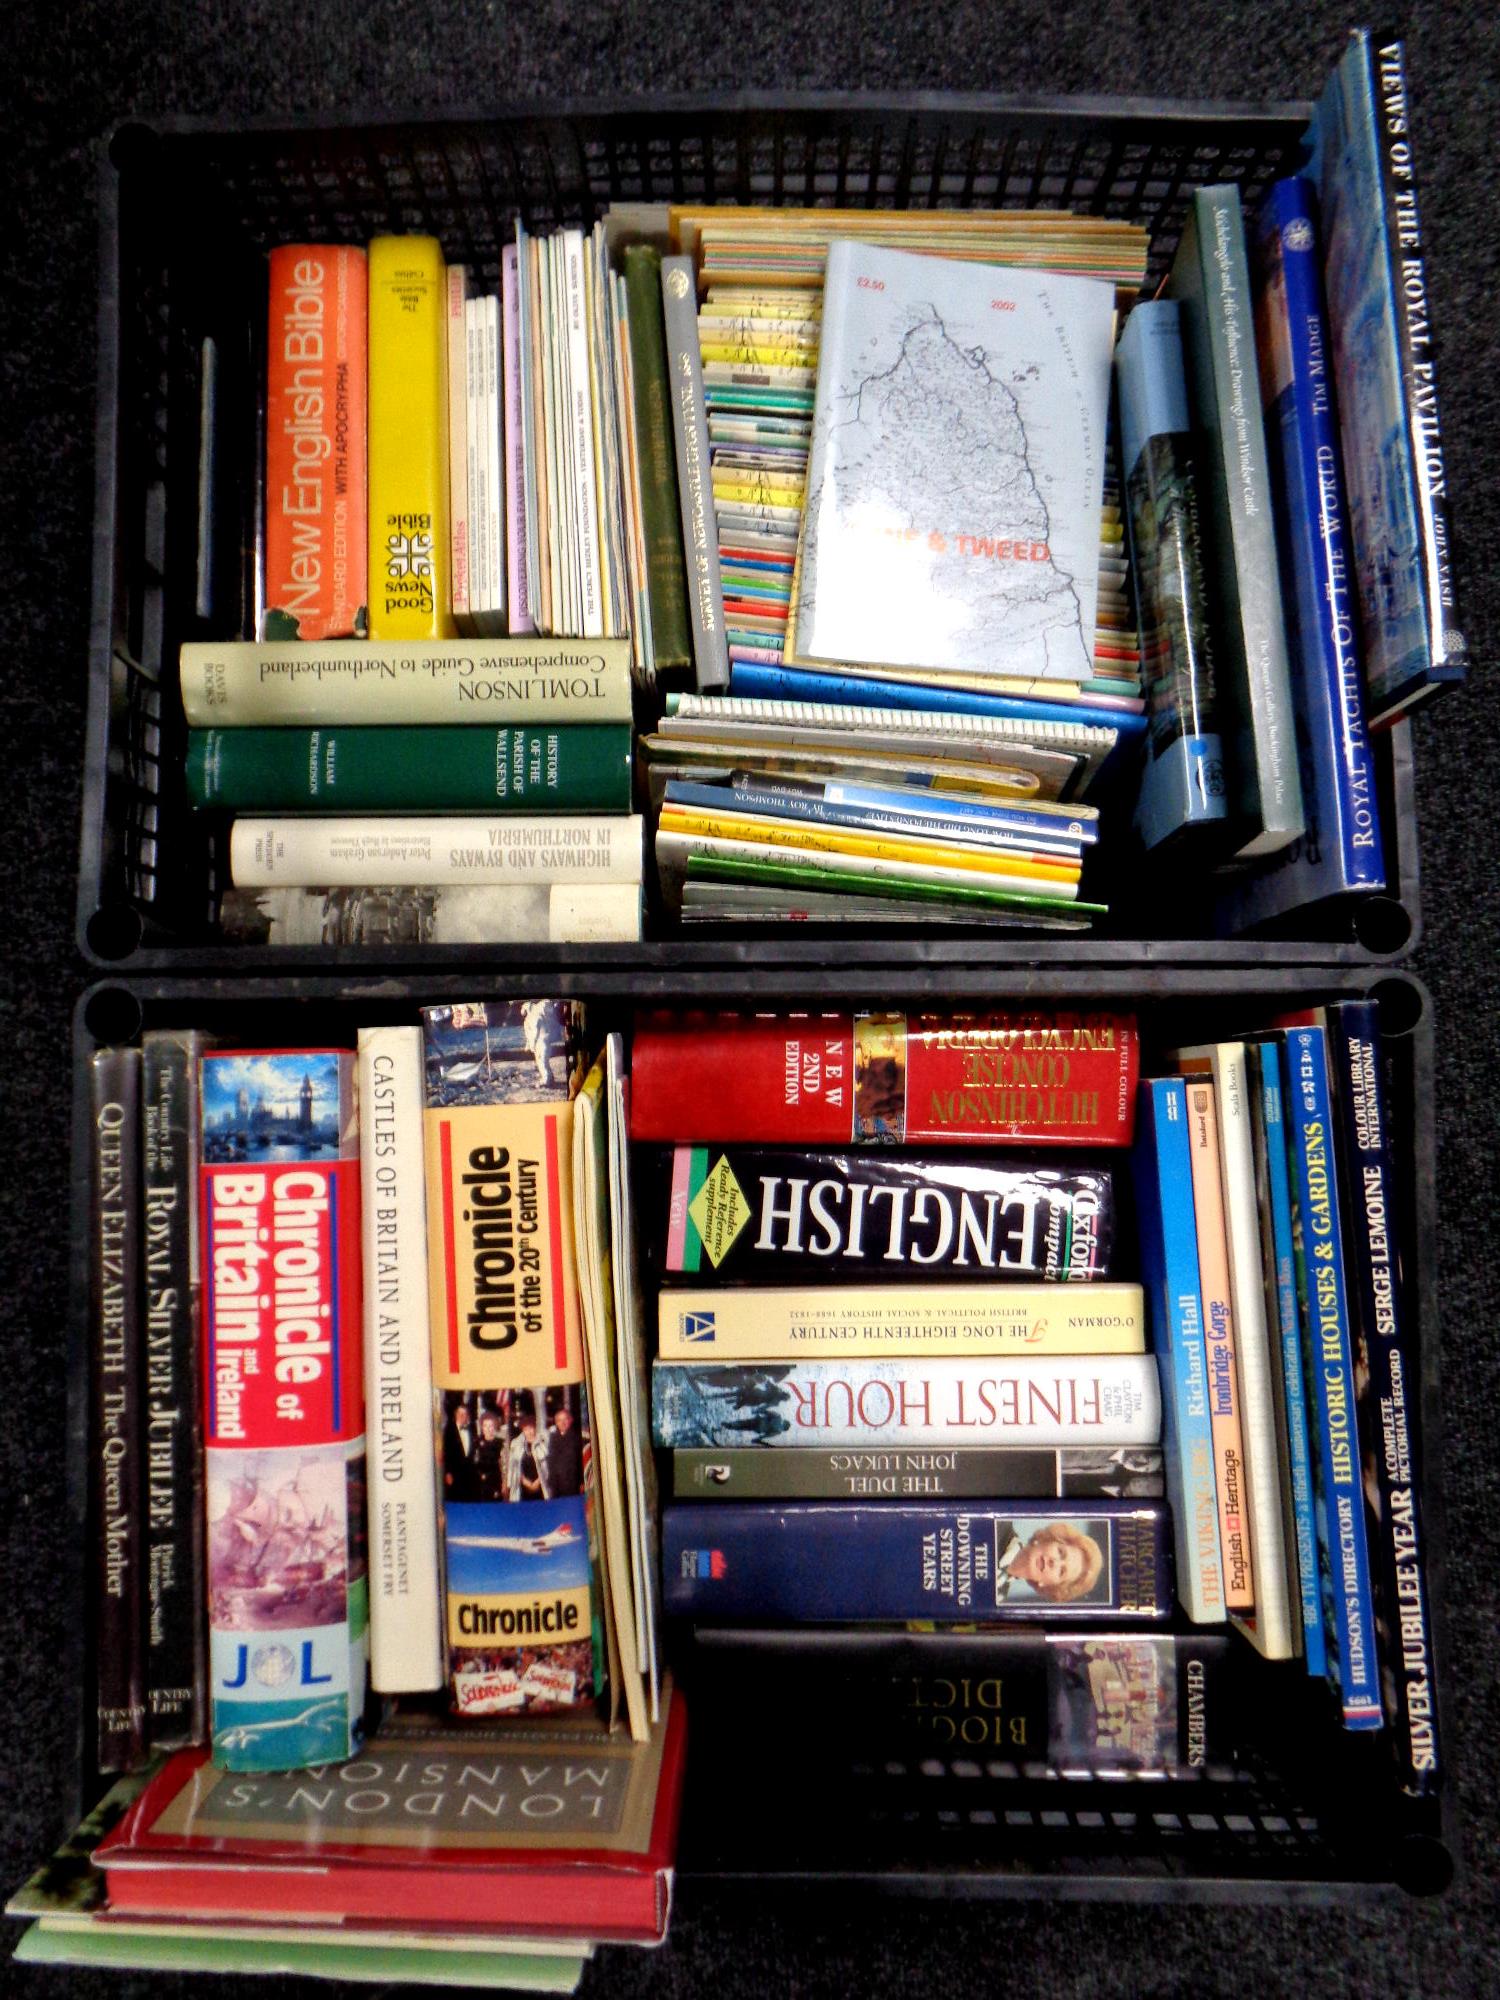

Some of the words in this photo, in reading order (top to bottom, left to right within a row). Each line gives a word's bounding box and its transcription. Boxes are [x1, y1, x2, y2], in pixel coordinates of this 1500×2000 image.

[1378, 42, 1408, 135] VIEWS
[1390, 142, 1412, 180] OF
[1394, 189, 1420, 249] THE
[283, 259, 324, 361] Bible
[1401, 259, 1430, 352] ROYAL
[1307, 314, 1325, 376] MADGE
[335, 362, 348, 453] APOCRYPHA
[1228, 369, 1247, 416] Drawings
[1312, 381, 1328, 415] TIM
[282, 369, 330, 515] English
[1233, 418, 1250, 440] from
[1411, 361, 1447, 499] PAVILION
[335, 456, 348, 495] WITH
[1238, 443, 1257, 486] Windsor
[516, 475, 525, 513] FAMILY
[687, 466, 708, 550] NEWCASTLE
[1243, 487, 1259, 517] Castle
[1317, 446, 1341, 534] WORLD
[386, 513, 432, 529] Bible
[454, 520, 466, 554] Atlas
[1433, 514, 1448, 559] JOHN
[282, 520, 323, 615] New
[954, 530, 1051, 561] TWEED
[385, 582, 434, 598] News
[518, 547, 528, 618] DISCOVERING
[1328, 550, 1349, 594] THE
[1439, 564, 1453, 607] NASH
[385, 597, 434, 614] Good
[698, 576, 714, 632] SURVEY
[1332, 611, 1352, 646] OF
[215, 664, 226, 704] DAVIS
[259, 659, 396, 678] Northumberland
[401, 659, 416, 672] to
[422, 656, 474, 675] Guide
[480, 653, 606, 675] Comprehensive
[458, 678, 605, 700] TOMLINSON
[1341, 658, 1366, 751] YACHTS
[310, 731, 319, 794] RICHARDSON
[326, 739, 335, 785] WILLIAM
[497, 729, 508, 797] WALLSEND
[513, 730, 524, 773] PARISH
[531, 739, 541, 756] OF
[547, 734, 558, 788] HISTORY
[1267, 726, 1281, 777] Buckingham
[513, 776, 524, 793] OF
[531, 759, 541, 784] THE
[1273, 779, 1285, 804] Palace
[735, 792, 785, 806] THOMPSON
[788, 799, 807, 810] ROY
[1351, 763, 1374, 847] ROYAL
[330, 847, 364, 860] Graham
[367, 848, 407, 860] Anderson
[410, 848, 431, 860] Peter
[449, 849, 504, 869] BYWAYS
[487, 829, 592, 847] NORTHUMBRIA
[508, 849, 536, 869] AND
[541, 849, 611, 868] HIGHWAYS
[597, 829, 611, 846] IN
[160, 1067, 173, 1090] The
[785, 1040, 799, 1105] EDITION
[803, 1053, 820, 1094] 2ND
[962, 1053, 1070, 1087] CONCISE
[1226, 1064, 1238, 1091] Books
[1348, 1037, 1364, 1092] LIBRARY
[158, 1093, 173, 1142] Country
[373, 1056, 395, 1158] CASTLES
[928, 1090, 1100, 1124] HUTCHINSON
[1117, 1079, 1128, 1121] COLOUR
[1229, 1093, 1241, 1117] Scala
[1361, 1042, 1382, 1149] INTERNATIONAL
[1353, 1094, 1370, 1150] COLOUR
[98, 1103, 124, 1201] QUEEN
[160, 1146, 173, 1171] Life
[376, 1167, 397, 1197] OF
[516, 1158, 539, 1233] Century
[718, 1163, 730, 1200] Ready
[1303, 1122, 1331, 1236] GARDENS
[669, 1191, 685, 1230] New
[704, 1178, 718, 1245] supplement
[713, 1202, 728, 1259] Reference
[725, 1185, 739, 1237] Includes
[753, 1175, 1036, 1271] ENGLISH
[1364, 1166, 1390, 1264] LEMOINE
[147, 1185, 177, 1284] ROYAL
[212, 1173, 269, 1342] Britain
[377, 1209, 399, 1304] BRITAIN
[461, 1146, 519, 1351] Chronicle
[1316, 1240, 1332, 1260] &
[101, 1211, 126, 1373] ELIZABETH
[273, 1171, 330, 1384] Chronicle
[523, 1276, 542, 1308] the
[1373, 1267, 1396, 1334] SERGE
[524, 1312, 542, 1333] of
[789, 1325, 858, 1341] CENTURY
[840, 1309, 882, 1318] HISTORY
[863, 1324, 957, 1340] EIGHTEENTH
[885, 1310, 922, 1318] SOCIAL
[934, 1309, 987, 1318] POLITICAL
[961, 1324, 1003, 1340] LONG
[990, 1309, 1028, 1318] BRITISH
[1068, 1315, 1134, 1329] O'GORMAN
[1178, 1294, 1198, 1335] Hall
[1207, 1301, 1228, 1341] Gorge
[1311, 1266, 1341, 1360] HOUSES
[147, 1288, 178, 1394] SILVER
[243, 1348, 259, 1374] and
[379, 1314, 400, 1365] AND
[1181, 1339, 1204, 1417] Richard
[1209, 1345, 1233, 1417] Ironbridge
[1284, 1338, 1299, 1398] celebration
[1388, 1349, 1404, 1407] RECORD
[103, 1387, 126, 1434] The
[216, 1348, 245, 1439] Ireland
[275, 1394, 302, 1420] of
[785, 1378, 932, 1429] HOUR
[945, 1377, 1103, 1427] FINEST
[380, 1376, 403, 1483] IRELAND
[1290, 1401, 1306, 1463] anniversary
[1322, 1368, 1352, 1483] HISTORIC
[1381, 1397, 1398, 1471] COMPLETE
[1396, 1409, 1411, 1482] PICTORIAL
[103, 1438, 125, 1512] Queen
[148, 1401, 181, 1529] JUBILEE
[829, 1454, 901, 1471] LUKACS
[844, 1475, 896, 1492] DUEL
[902, 1475, 943, 1492] THE
[905, 1453, 958, 1471] JOHN
[1221, 1449, 1241, 1516] Heritage
[381, 1502, 394, 1572] SOMERSET
[1196, 1481, 1218, 1558] VIKING
[1390, 1489, 1416, 1561] YEAR
[106, 1515, 128, 1597] Mother
[161, 1544, 174, 1589] Patrick
[396, 1502, 408, 1597] PLANTAGENET
[922, 1532, 937, 1591] YEARS
[939, 1527, 954, 1596] STREET
[957, 1513, 972, 1607] DOWNING
[975, 1542, 988, 1580] THE
[1228, 1532, 1247, 1591] English
[1336, 1494, 1359, 1593] DIRECTORY
[383, 1574, 394, 1598] FRY
[1202, 1563, 1220, 1607] THE
[1303, 1581, 1316, 1597] TV
[457, 1601, 579, 1634] Chronicle
[1396, 1563, 1427, 1674] JUBILEE
[1345, 1597, 1367, 1685] HUDSON'S
[1188, 1659, 1205, 1767] CHAMBERS
[1404, 1679, 1436, 1771] SILVER
[223, 1782, 605, 1818] LONDON'S
